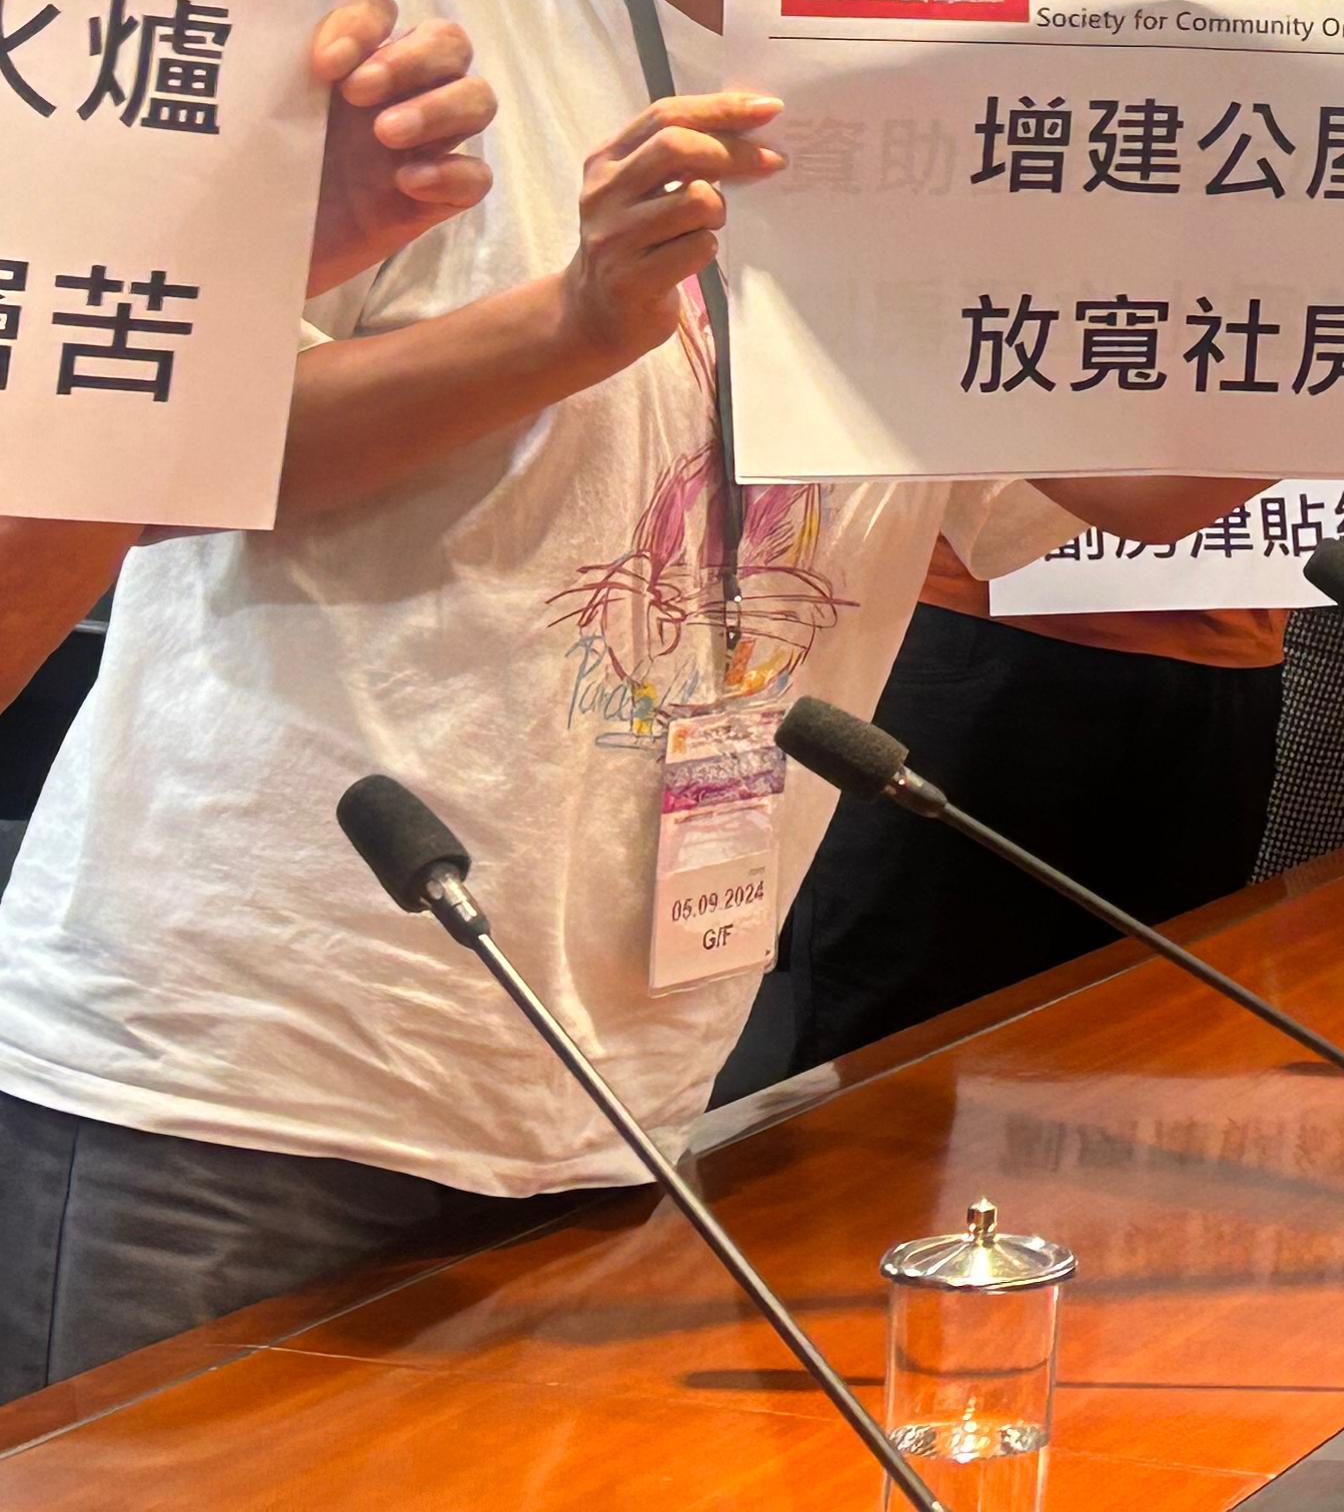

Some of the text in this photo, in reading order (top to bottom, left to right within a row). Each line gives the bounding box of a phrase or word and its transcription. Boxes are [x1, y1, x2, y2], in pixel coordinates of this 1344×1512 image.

[1036, 7, 1125, 31] Society
[1134, 9, 1168, 31] for
[1175, 11, 1314, 42] Community
[671, 879, 765, 924] 05.09.2024
[702, 923, 734, 951] G/F
